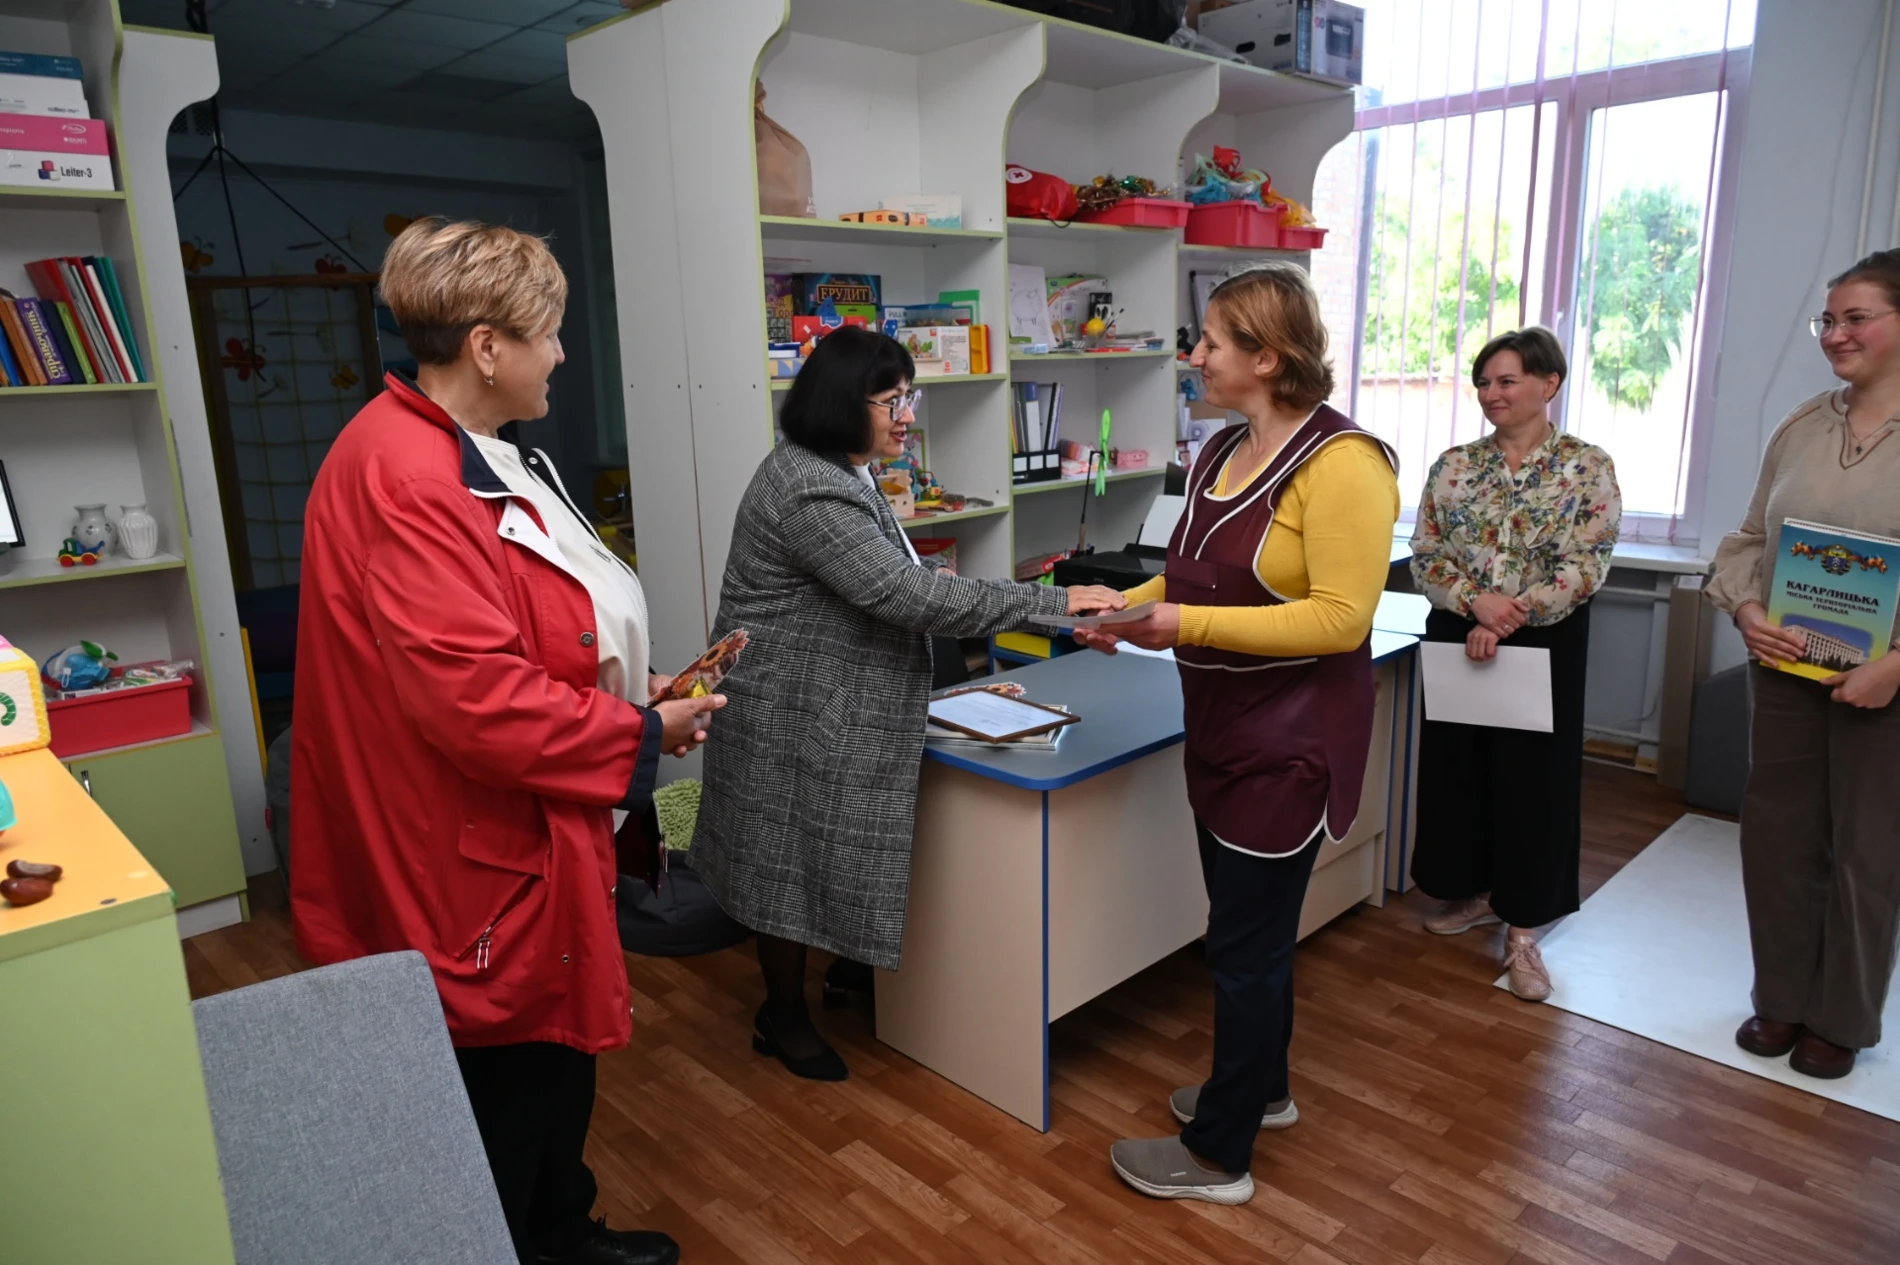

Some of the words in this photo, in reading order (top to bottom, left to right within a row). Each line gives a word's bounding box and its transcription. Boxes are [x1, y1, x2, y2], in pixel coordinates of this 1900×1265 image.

[60, 166, 93, 178] Leiter-3
[820, 287, 868, 303] ЕРУДИТ
[26, 311, 61, 379] Справочник
[1786, 580, 1880, 607] КАГАРЛИЦЬКА
[1786, 590, 1813, 601] МІСЬКА
[1815, 597, 1878, 615] ТЕРИТОРІАЛЬНА
[1813, 603, 1849, 616] ГРОМАДА
